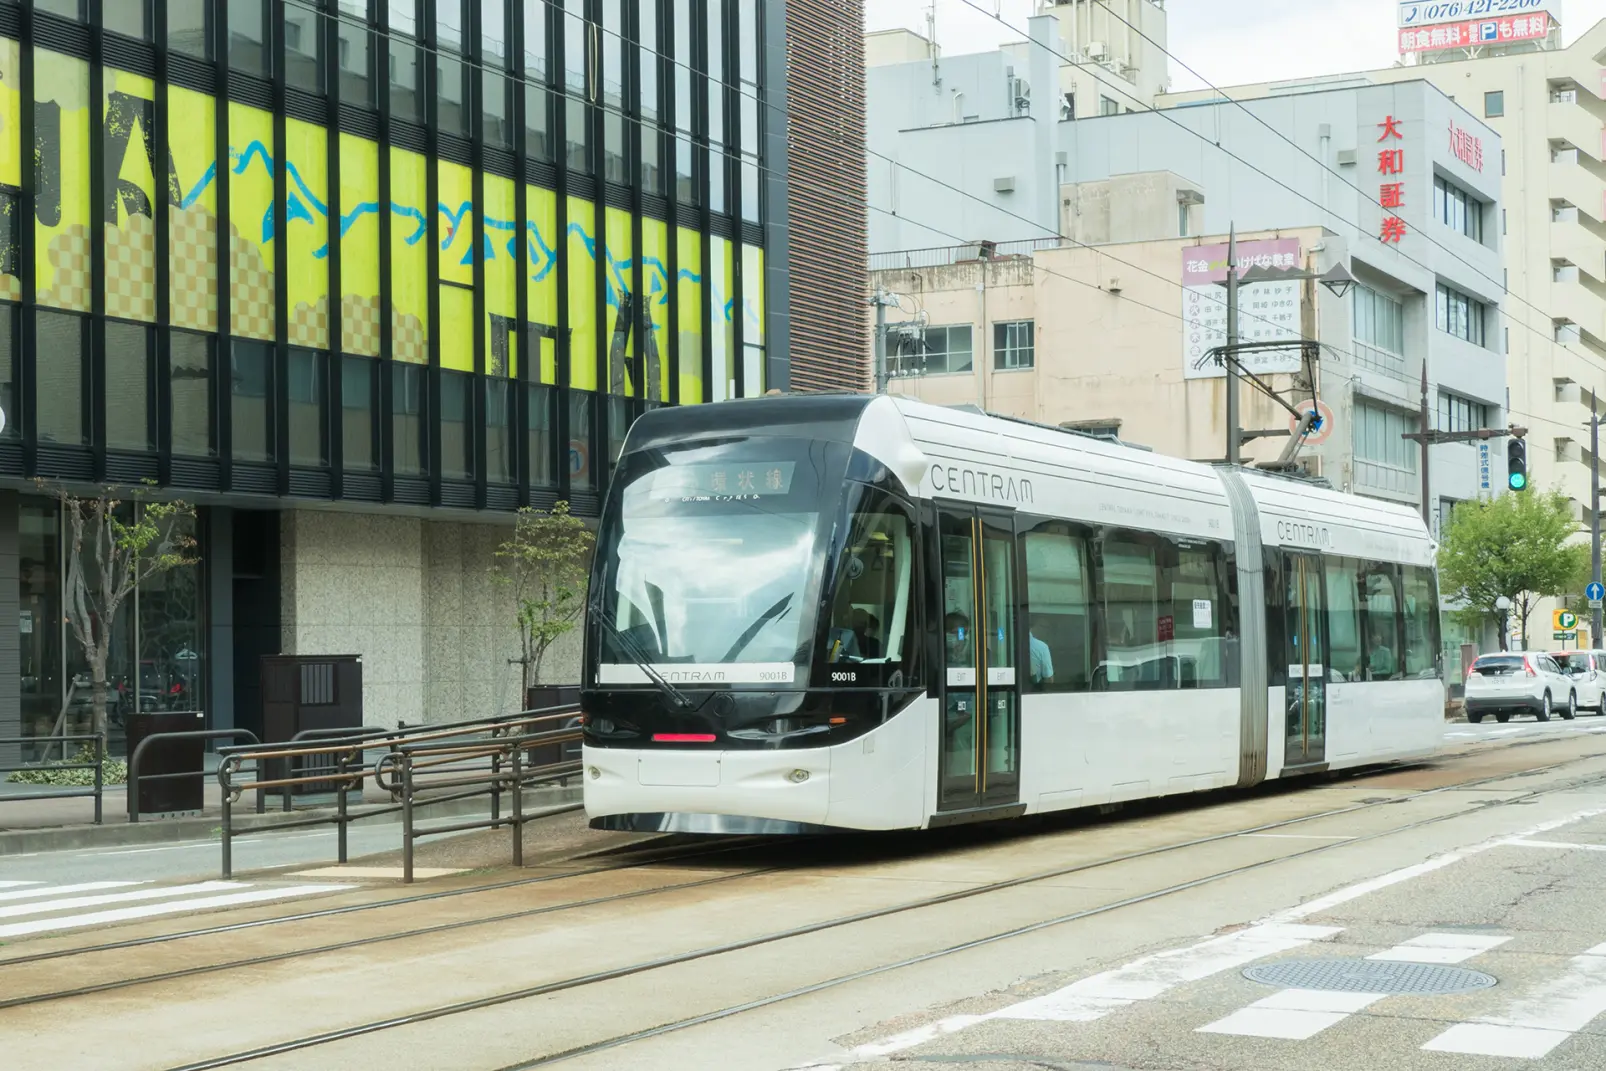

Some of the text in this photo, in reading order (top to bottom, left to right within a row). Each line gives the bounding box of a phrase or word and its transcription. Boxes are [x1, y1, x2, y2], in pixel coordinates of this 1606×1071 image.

[1448, 119, 1483, 174] 大和証券
[1377, 115, 1406, 244] 大和証券
[711, 467, 784, 491] 環状線
[930, 463, 1035, 504] CENTRAM
[1277, 520, 1330, 546] CENTRAM
[1563, 612, 1574, 627] P
[652, 671, 788, 681] ENTRAM 9001B
[831, 671, 857, 682] 9001B
